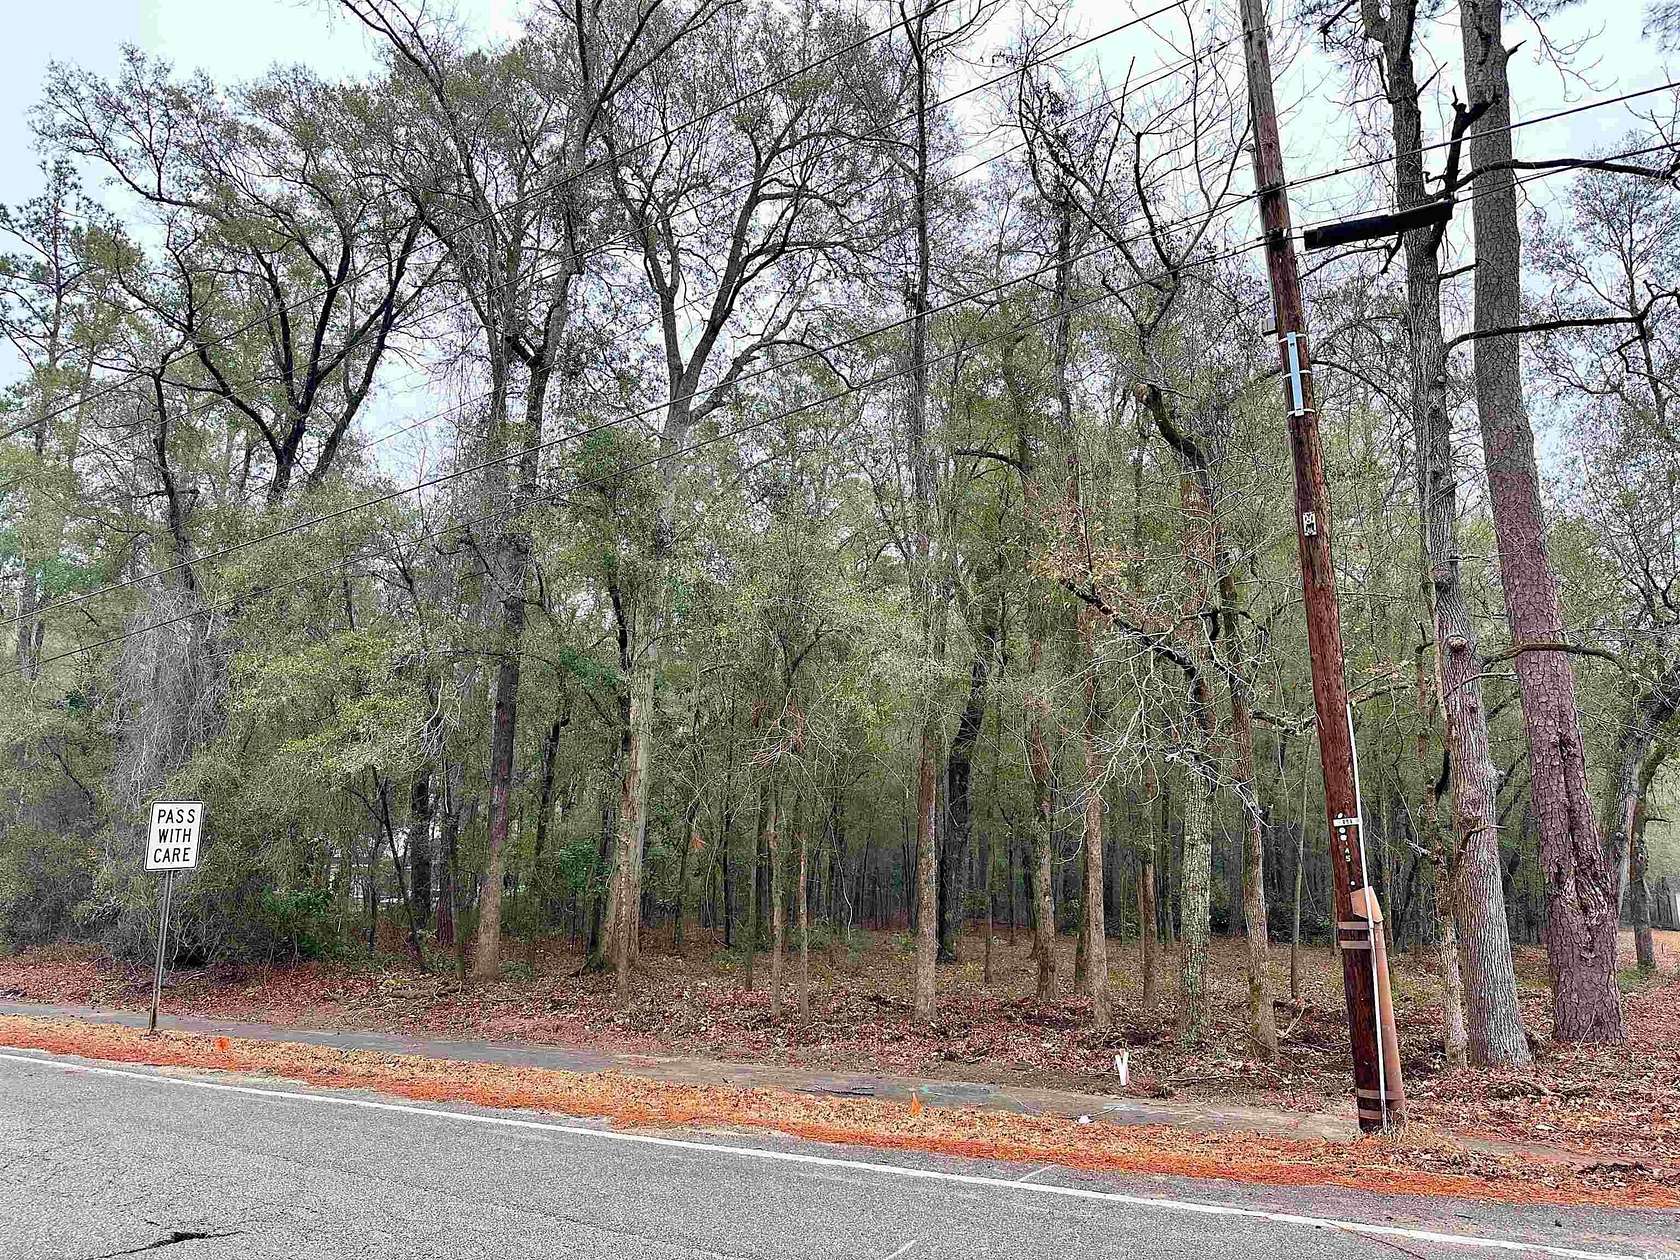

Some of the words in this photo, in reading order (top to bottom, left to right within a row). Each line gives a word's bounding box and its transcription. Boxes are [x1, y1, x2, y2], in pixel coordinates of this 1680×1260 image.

[157, 808, 196, 824] PASS
[158, 828, 192, 843] WITH
[153, 847, 192, 863] CARE
